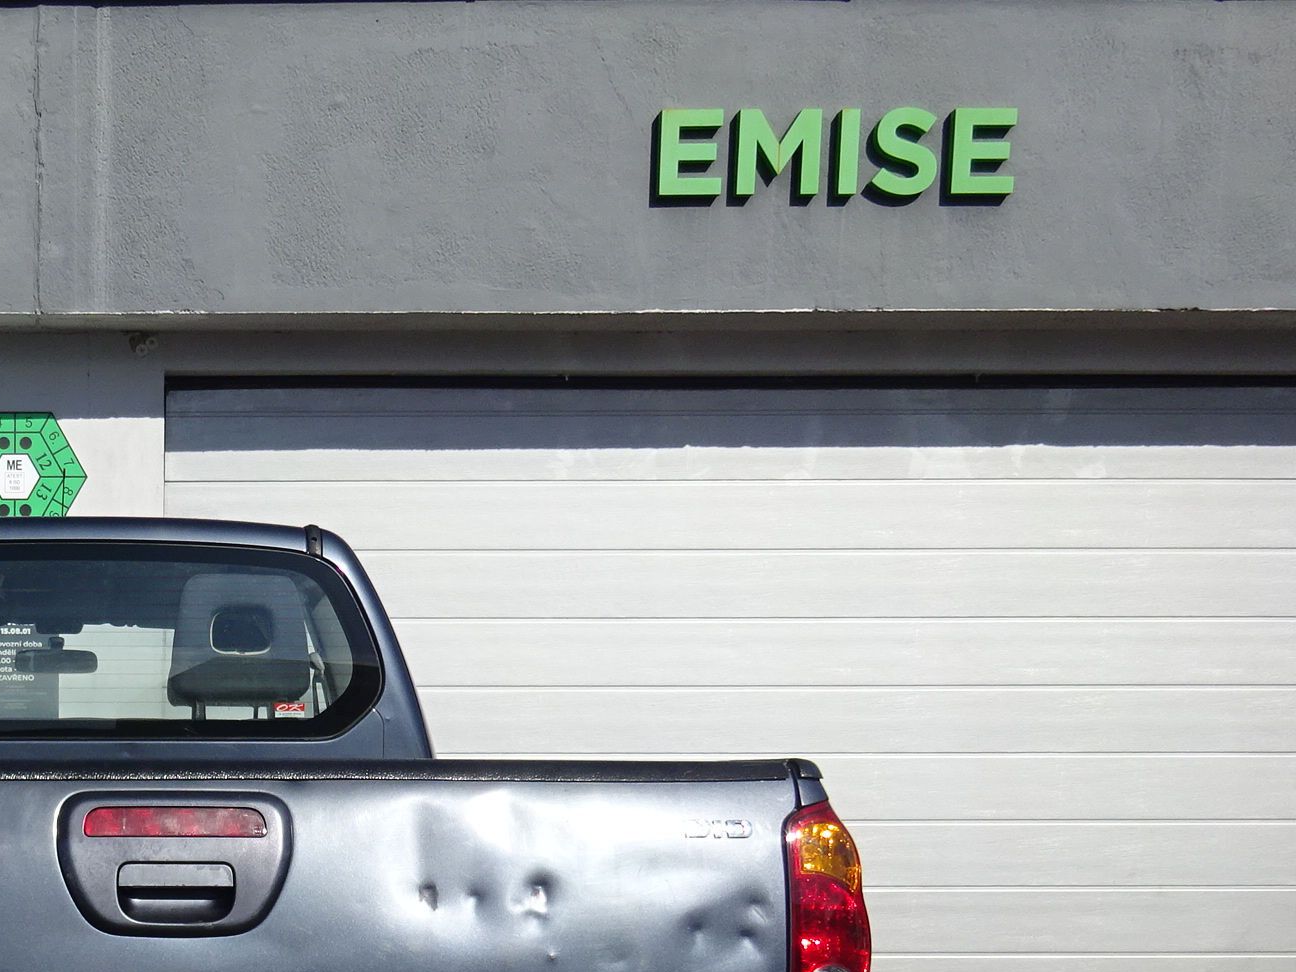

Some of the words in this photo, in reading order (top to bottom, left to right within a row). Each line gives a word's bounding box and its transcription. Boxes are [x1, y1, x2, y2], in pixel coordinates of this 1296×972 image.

[653, 107, 1019, 203] EMISE
[24, 418, 33, 428] 5
[6, 460, 22, 470] ME
[35, 453, 52, 470] 12
[63, 458, 75, 467] 7
[36, 484, 53, 501] 13
